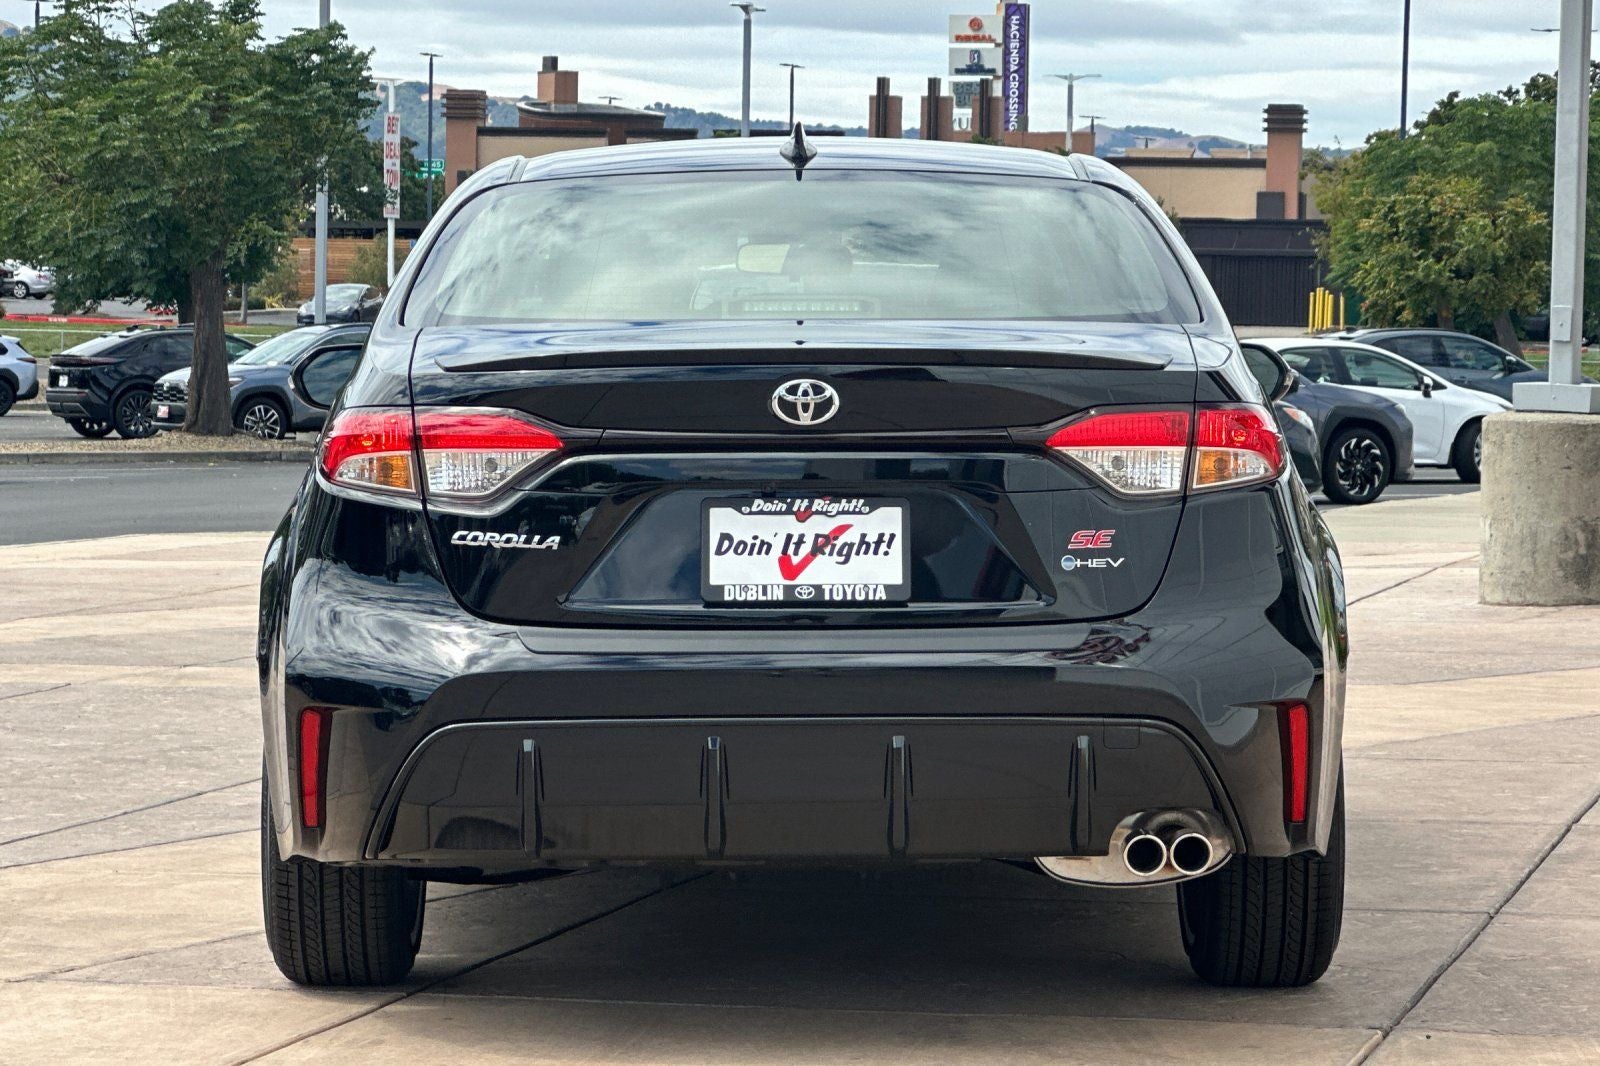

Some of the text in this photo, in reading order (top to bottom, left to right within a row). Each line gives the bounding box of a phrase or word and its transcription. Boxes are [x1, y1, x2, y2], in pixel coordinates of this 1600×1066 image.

[1009, 15, 1020, 132] HACIENDA CROSSING
[751, 498, 863, 516] Doin' It Right!
[450, 530, 560, 550] COROLLA
[714, 532, 897, 565] Doin' It Right!
[1067, 529, 1116, 549] SE
[723, 584, 887, 601] DUBLIN TOYOTA
